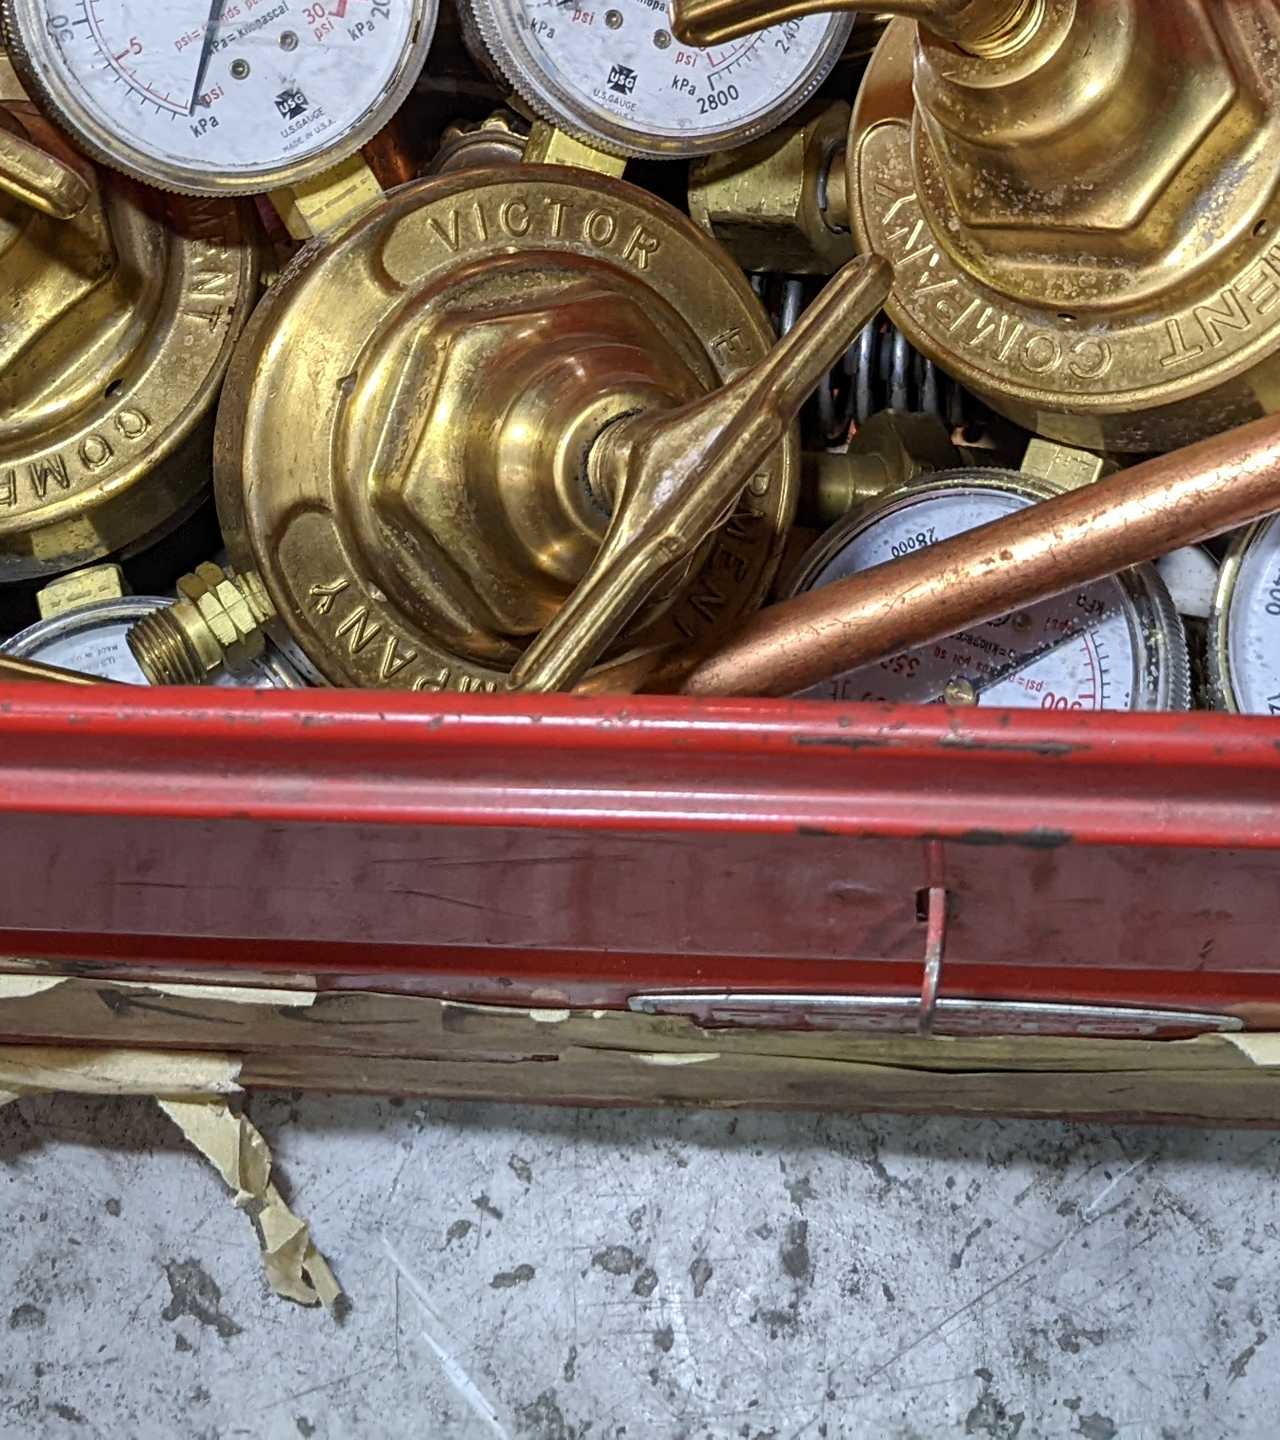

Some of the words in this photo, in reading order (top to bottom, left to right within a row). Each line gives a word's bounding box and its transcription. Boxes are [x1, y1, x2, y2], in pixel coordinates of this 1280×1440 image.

[302, 2, 327, 26] 30
[572, 9, 596, 26] psi
[312, 18, 336, 42] psi
[346, 18, 377, 42] kPa
[530, 17, 556, 40] kPa
[128, 35, 144, 56] 5
[675, 50, 698, 68] psi
[671, 74, 698, 97] kPa
[696, 83, 741, 115] 2800
[190, 114, 221, 139] kPa
[426, 194, 661, 271] VICTOR
[874, 182, 1114, 381] COMPANY
